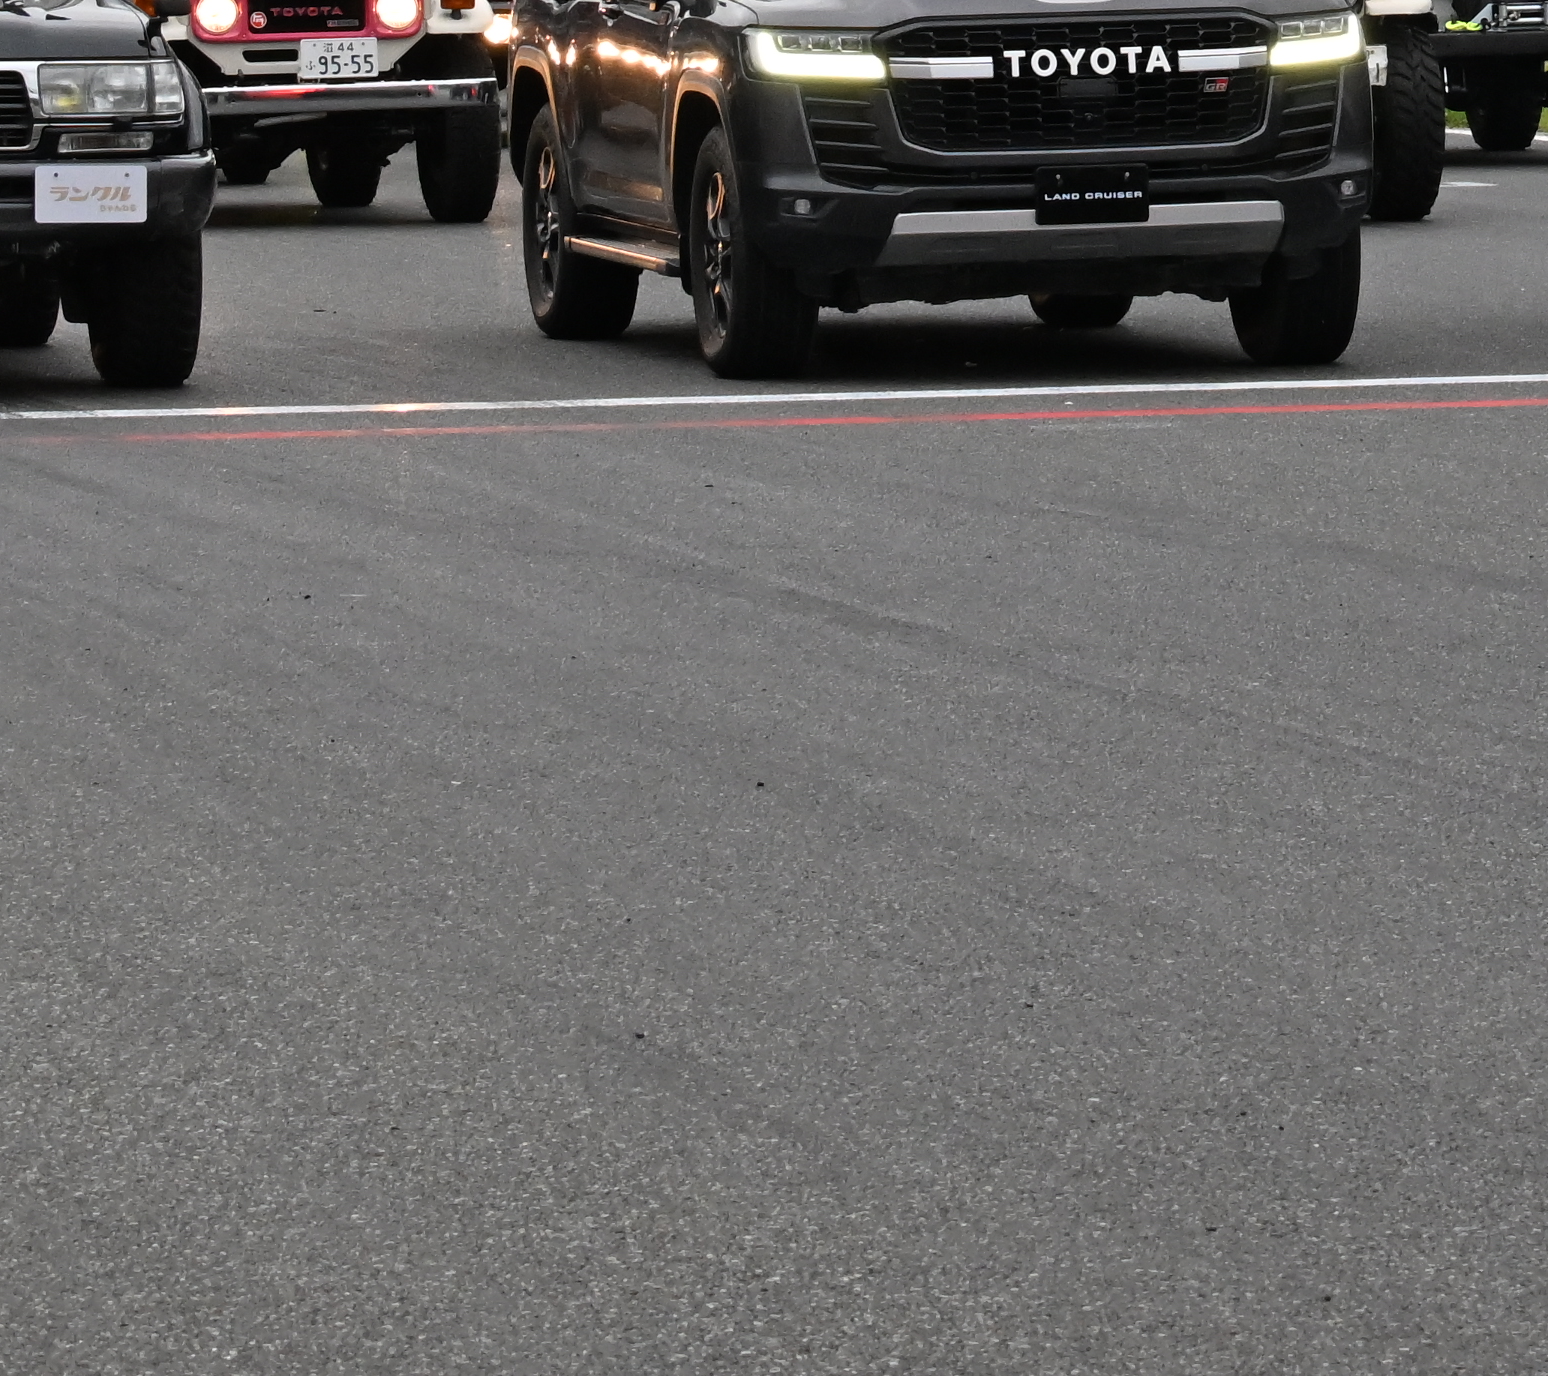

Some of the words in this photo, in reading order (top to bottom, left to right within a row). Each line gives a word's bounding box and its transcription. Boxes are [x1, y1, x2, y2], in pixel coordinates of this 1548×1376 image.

[270, 7, 343, 17] TOYOTA
[337, 42, 354, 52] 44
[318, 54, 374, 75] 95-55
[1003, 45, 1172, 78] TOYOTA
[1205, 81, 1228, 92] GR
[49, 186, 132, 202] ランクル
[1044, 192, 1080, 201] LAND
[1084, 191, 1143, 200] CRUISER
